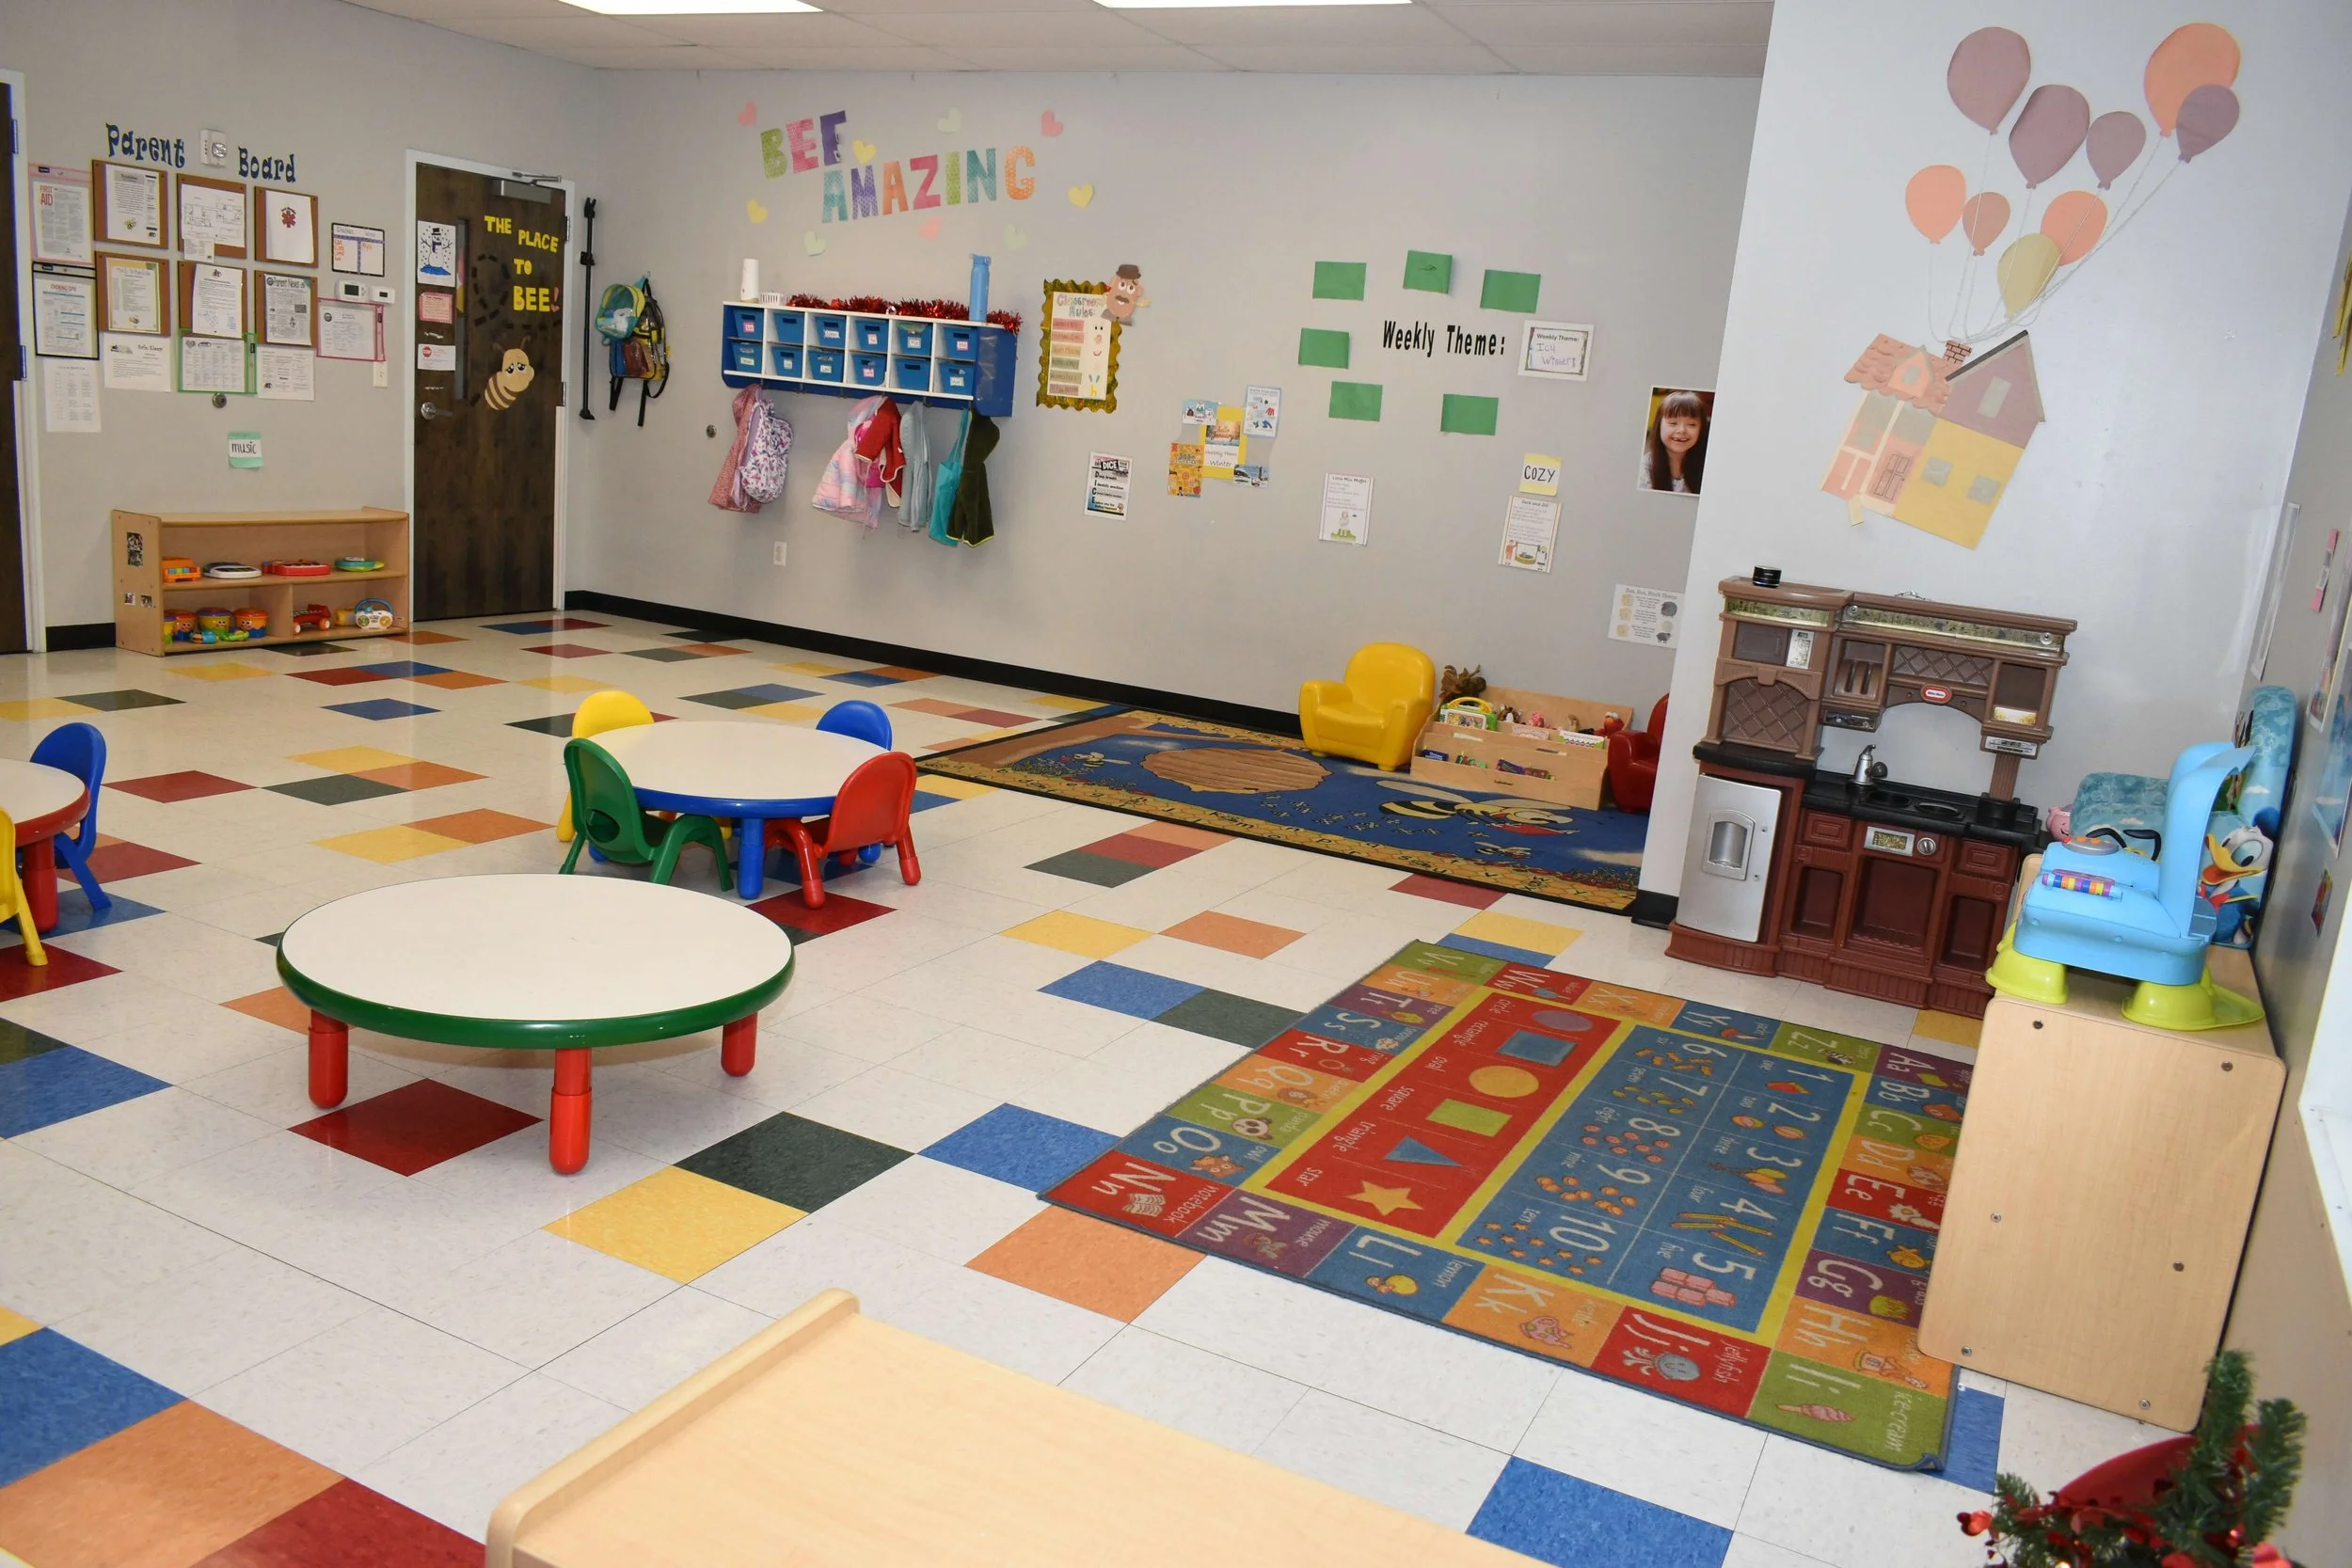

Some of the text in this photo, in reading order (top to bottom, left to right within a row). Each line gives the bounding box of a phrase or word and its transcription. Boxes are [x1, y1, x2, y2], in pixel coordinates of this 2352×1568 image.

[105, 122, 185, 168] Parent
[238, 145, 296, 182] Board
[821, 145, 1035, 223] AMAZING
[40, 193, 53, 206] AID
[484, 214, 513, 234] THE
[517, 229, 559, 253] PLACE
[514, 258, 532, 275] TO
[513, 285, 561, 313] BEE!
[1382, 321, 1505, 357] Weekly Theme:
[1536, 333, 1557, 341] Weekly
[231, 441, 257, 454] music
[1103, 461, 1118, 469] DICE
[1523, 465, 1556, 483] COZY
[1494, 968, 1550, 990] Ww
[1488, 999, 1511, 1014] circle
[1324, 1012, 1381, 1031] Ss
[1453, 1019, 1489, 1046] rectangle
[1289, 1035, 1349, 1057] Rr
[1682, 1043, 1727, 1058] 6
[1425, 1055, 1448, 1073] oval
[1885, 1052, 1936, 1073] Aa
[1236, 1065, 1313, 1089] Qq
[1660, 1076, 1708, 1097] 7
[1787, 1069, 1835, 1083] 1
[1379, 1085, 1415, 1111] square
[1878, 1081, 1931, 1102] Bb
[1200, 1093, 1271, 1120] Pp
[1767, 1101, 1821, 1122] 2
[1628, 1117, 1681, 1136] 8
[1867, 1110, 1923, 1132] Cc
[1153, 1127, 1221, 1154] Oo
[1333, 1120, 1376, 1152] triangle
[1244, 1145, 1268, 1164] owl
[1746, 1147, 1803, 1167] 3
[1857, 1139, 1915, 1171] Dd
[1091, 1161, 1176, 1196] Nn
[1295, 1166, 1323, 1187] star
[1597, 1164, 1651, 1184] 9
[1688, 1184, 1715, 1204] four
[1845, 1174, 1906, 1201] Ee
[1164, 1184, 1220, 1224] notebook
[1520, 1208, 1541, 1224] ten
[1720, 1197, 1777, 1221] 4
[1197, 1196, 1291, 1243] Mm
[1832, 1212, 1896, 1244] Ff
[1295, 1218, 1331, 1247] mouse
[1549, 1215, 1617, 1252] 10
[1657, 1241, 1685, 1259] five
[1434, 1259, 1474, 1288] lemon
[1692, 1252, 1757, 1280] 5
[1807, 1259, 1883, 1298] Gg
[1474, 1273, 1554, 1314] Kk
[1624, 1312, 1710, 1353] Jj
[1793, 1305, 1872, 1349] Hh
[1713, 1338, 1752, 1385] jellyfish
[1884, 1390, 1923, 1453] ice-cream
